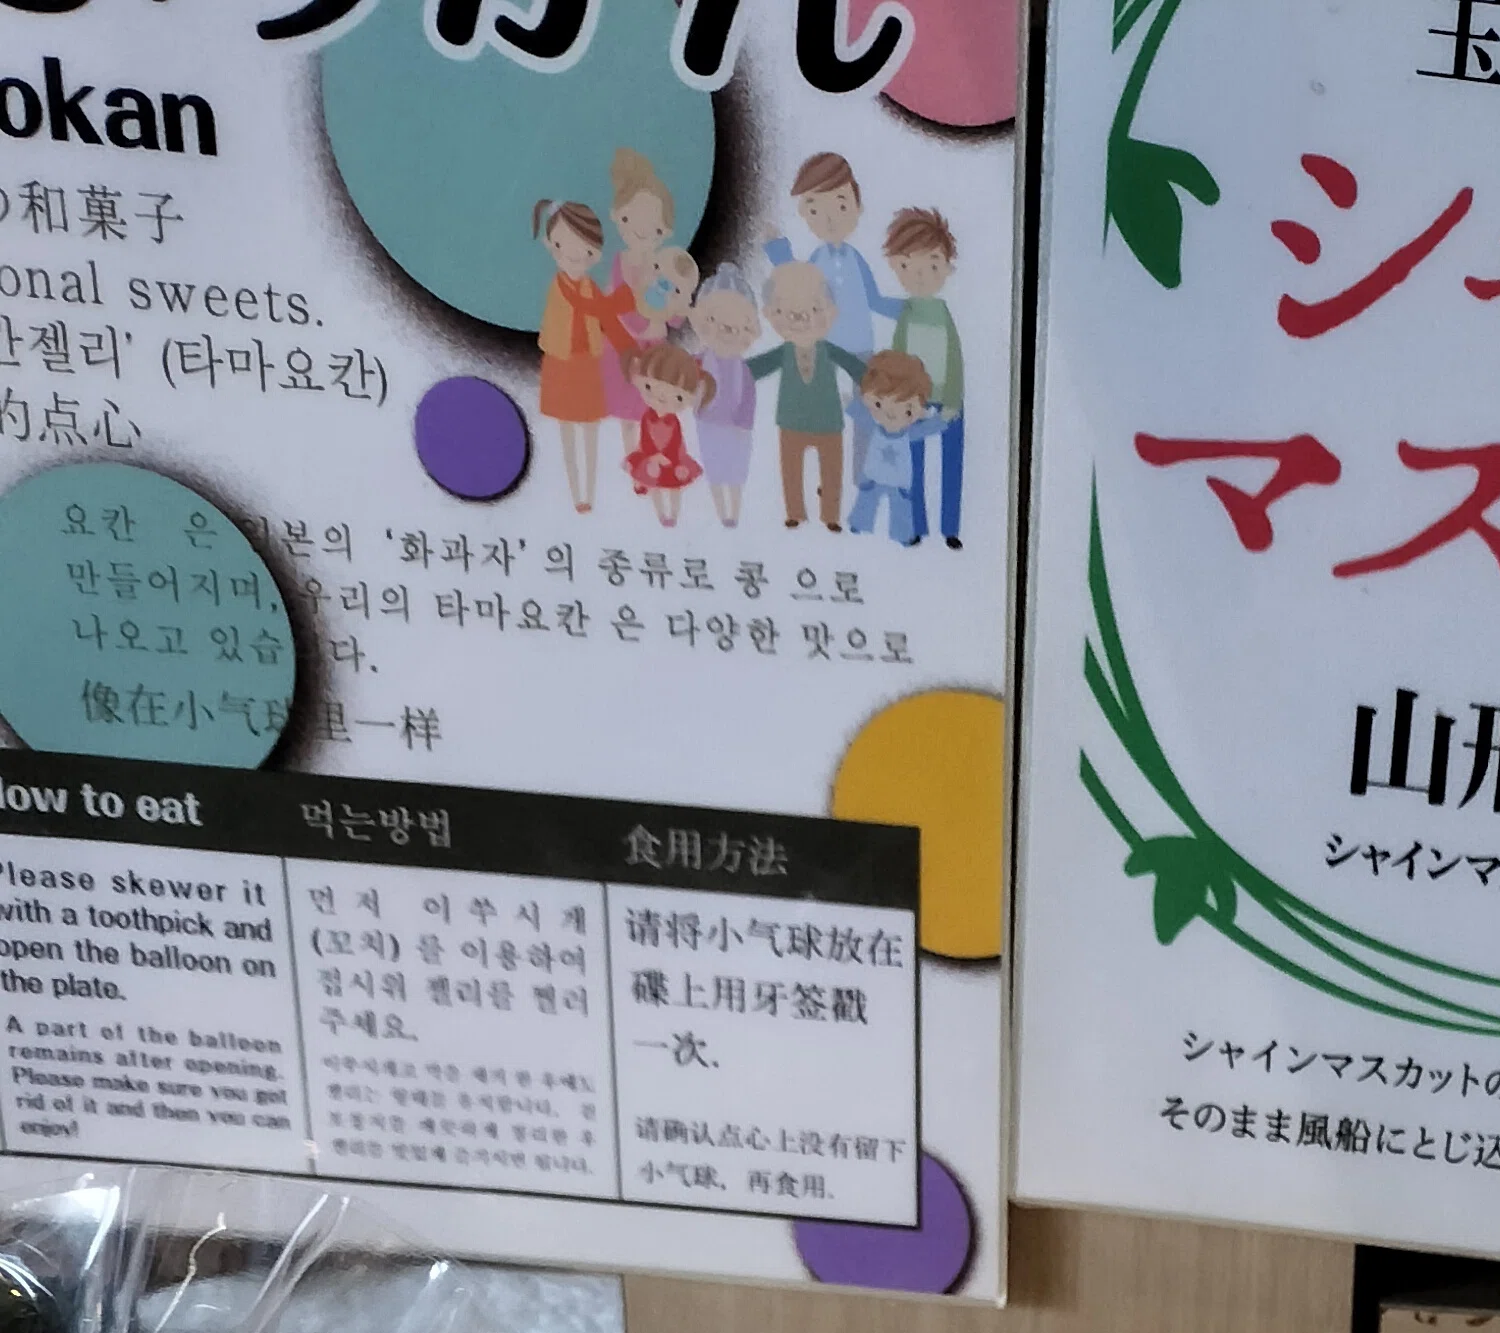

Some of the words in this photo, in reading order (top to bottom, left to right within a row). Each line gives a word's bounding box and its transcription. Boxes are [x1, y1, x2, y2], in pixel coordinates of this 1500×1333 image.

[0, 180, 183, 243] 和菓子
[129, 277, 324, 327] sweets.
[162, 333, 389, 406] (타마요칸)
[62, 504, 137, 542] 요칸
[184, 511, 217, 549] 은
[598, 548, 714, 590] 종류로
[734, 560, 769, 599] 콩
[790, 567, 864, 604] 으로
[66, 560, 278, 613] 만들어지며,
[302, 577, 410, 623] 우리의
[437, 589, 589, 638] 타마요칸
[611, 603, 645, 642] 은
[667, 608, 780, 655] 다양한
[803, 622, 914, 663] 맛으로
[73, 613, 189, 655] 나오고
[210, 626, 378, 673] 있습다.
[81, 783, 125, 818] to
[136, 793, 204, 826] eat
[302, 800, 451, 848] 먹는방법
[625, 824, 788, 876] 食用方法
[0, 861, 94, 891] lease
[112, 870, 228, 903] skewer
[243, 879, 266, 907] it
[62, 907, 78, 926] a
[89, 905, 215, 938] toothpick
[224, 918, 272, 942] and
[624, 908, 903, 968] 请将小气球放在
[0, 939, 63, 961] open
[75, 938, 120, 958] the
[130, 942, 233, 975] balloon
[242, 958, 276, 978] on
[1, 969, 43, 993] the
[52, 973, 127, 1001] plate.
[6, 1015, 23, 1034] A
